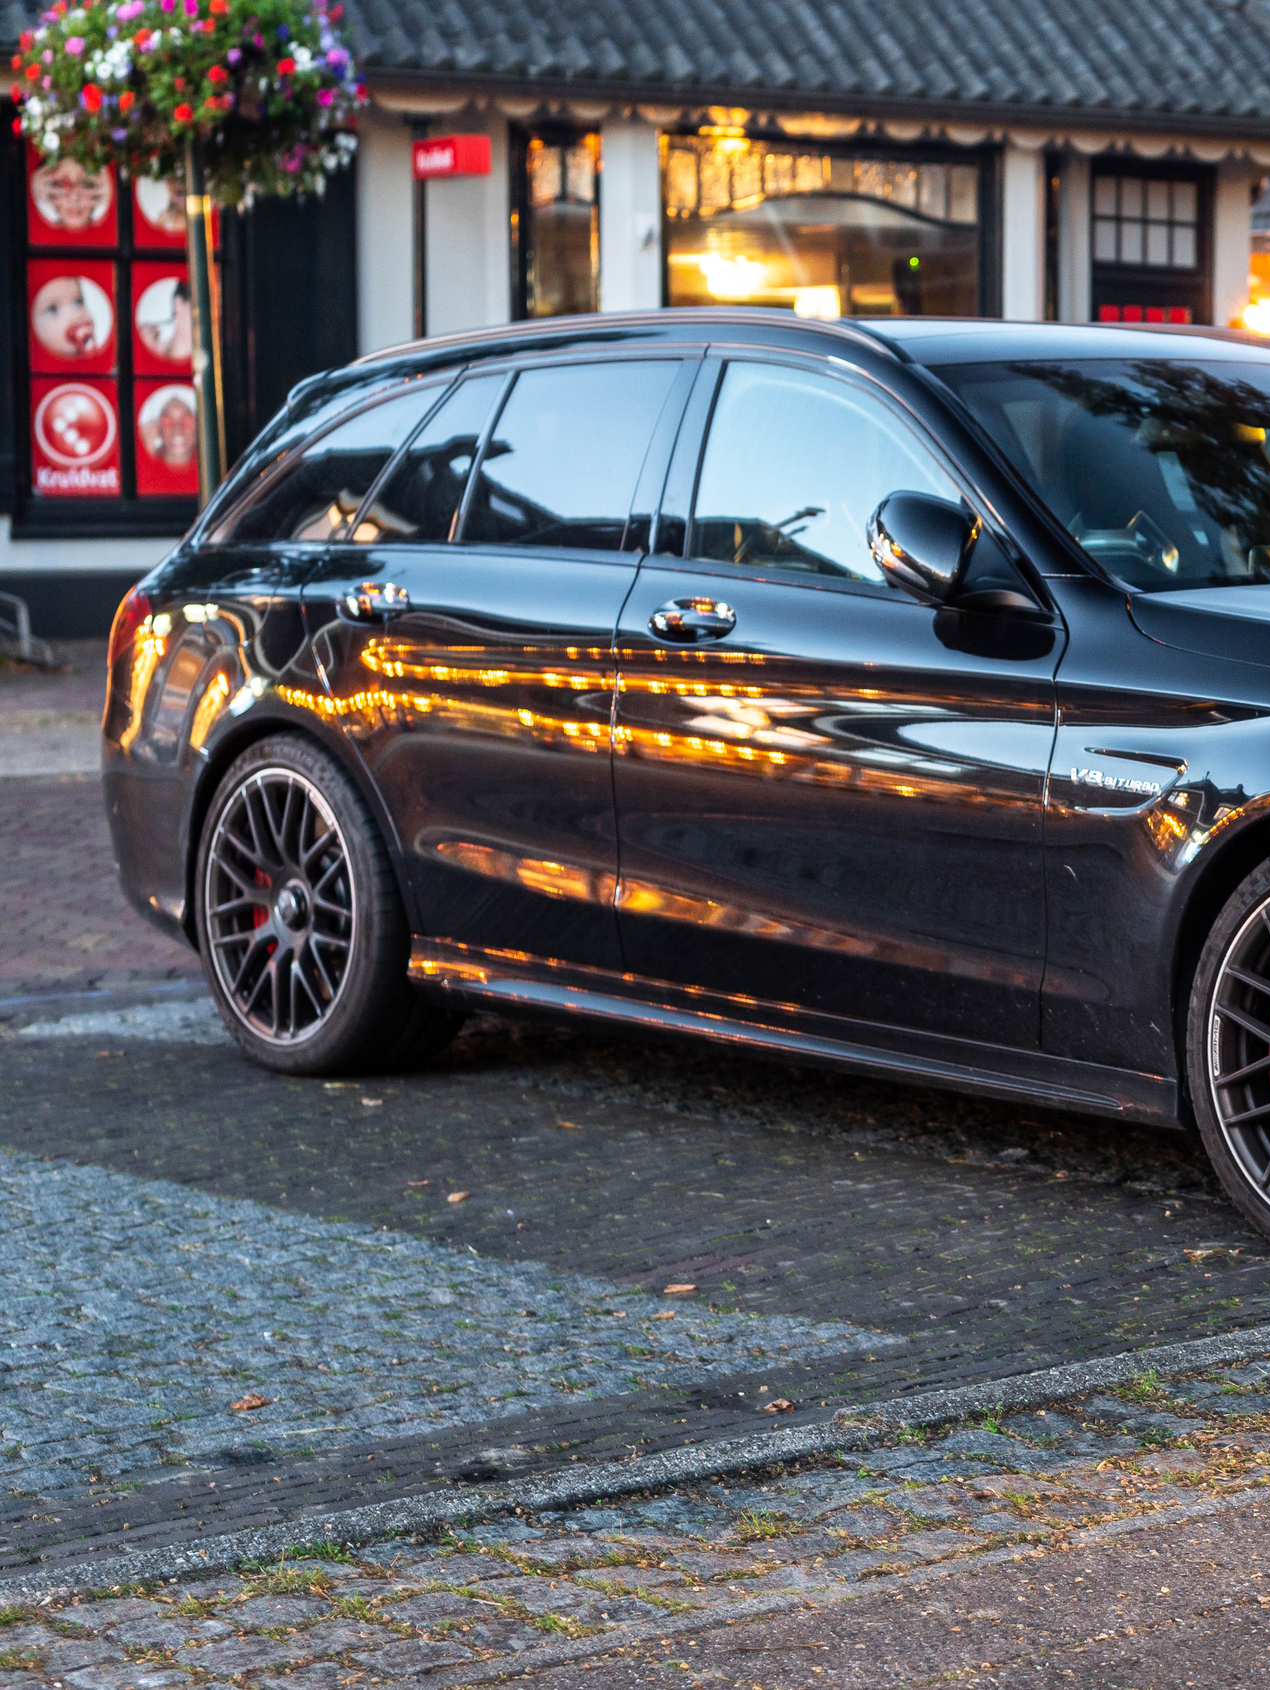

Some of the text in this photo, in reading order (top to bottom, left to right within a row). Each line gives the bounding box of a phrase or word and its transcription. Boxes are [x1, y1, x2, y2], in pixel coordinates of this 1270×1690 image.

[37, 467, 117, 488] Kruidvat
[1070, 767, 1161, 793] V8 BITURBO
